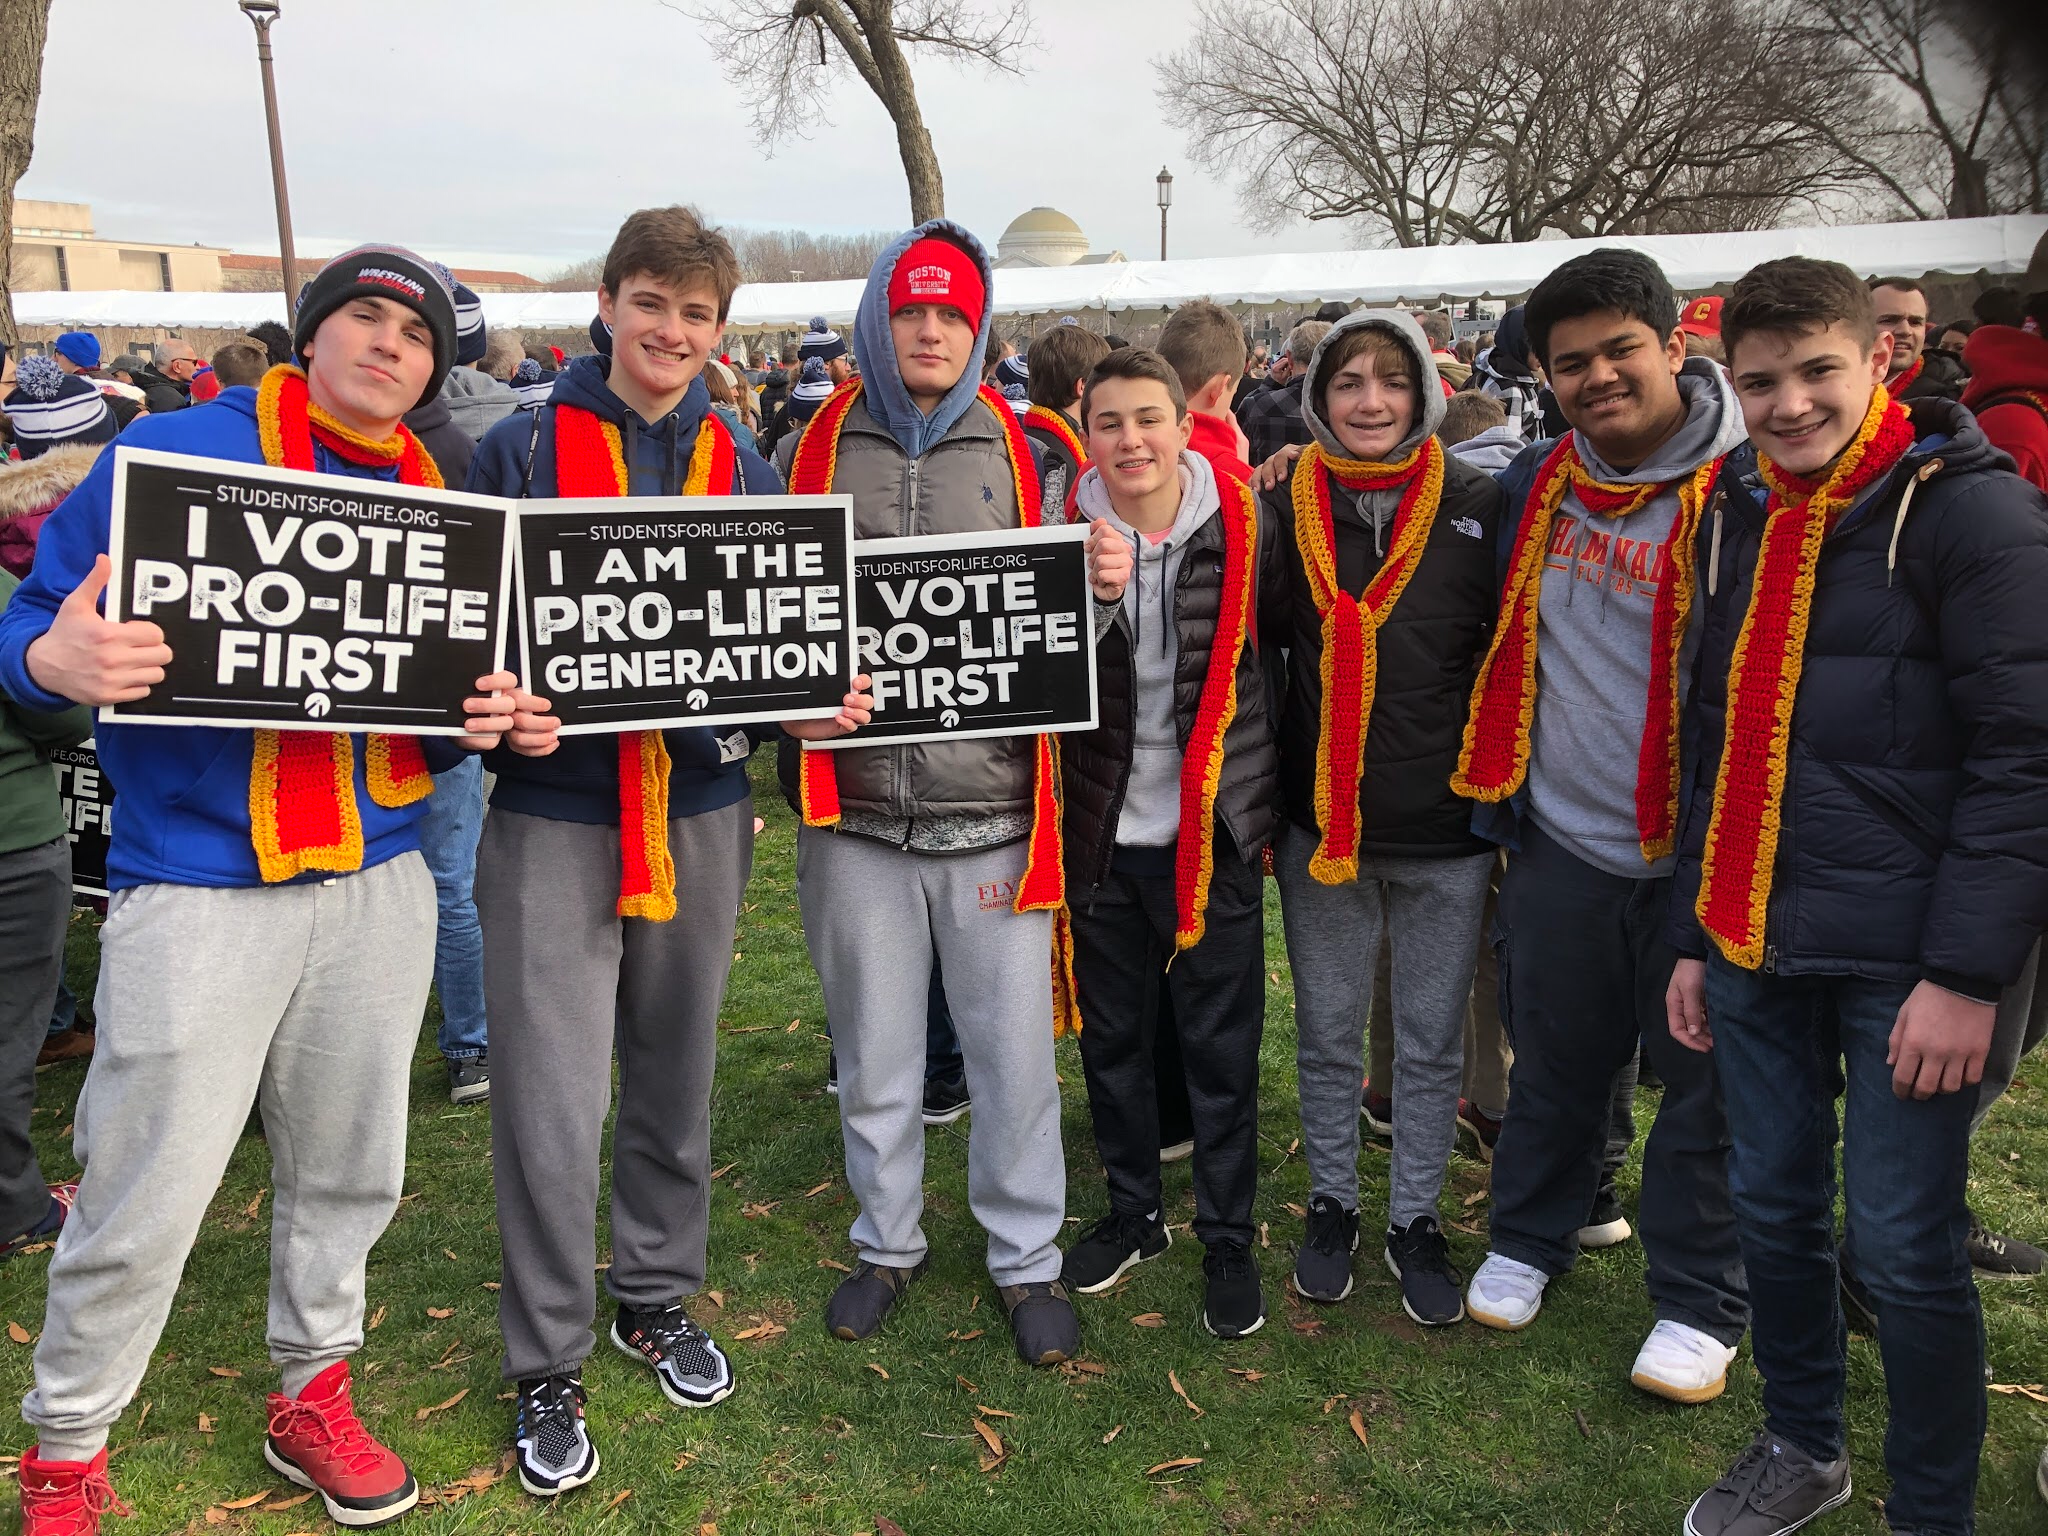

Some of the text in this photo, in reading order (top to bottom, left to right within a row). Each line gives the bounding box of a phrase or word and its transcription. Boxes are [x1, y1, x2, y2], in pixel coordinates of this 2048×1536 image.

[358, 268, 425, 295] WRESTLING
[908, 265, 951, 283] BOSTON
[910, 280, 949, 288] UNIVERSITY
[1693, 303, 1711, 321] C
[217, 485, 439, 527] STUDENTSFORLIFE.ORG
[1462, 516, 1474, 525] THE
[590, 522, 785, 541] STUDENTSFORLIFE.ORG
[1451, 518, 1473, 531] NORTH
[1457, 526, 1473, 536] FACE
[187, 505, 447, 581] I VOTE
[549, 543, 824, 585] I AM THE
[854, 553, 1027, 577] STUDENTSFORLIFE.ORG
[132, 559, 489, 641] PRO-LIFE
[875, 571, 1037, 619] VOTE
[534, 585, 842, 645] PRO-LIFE
[217, 629, 413, 693] FIRST
[545, 642, 837, 693] GENERATION
[871, 662, 1019, 712] FIRST
